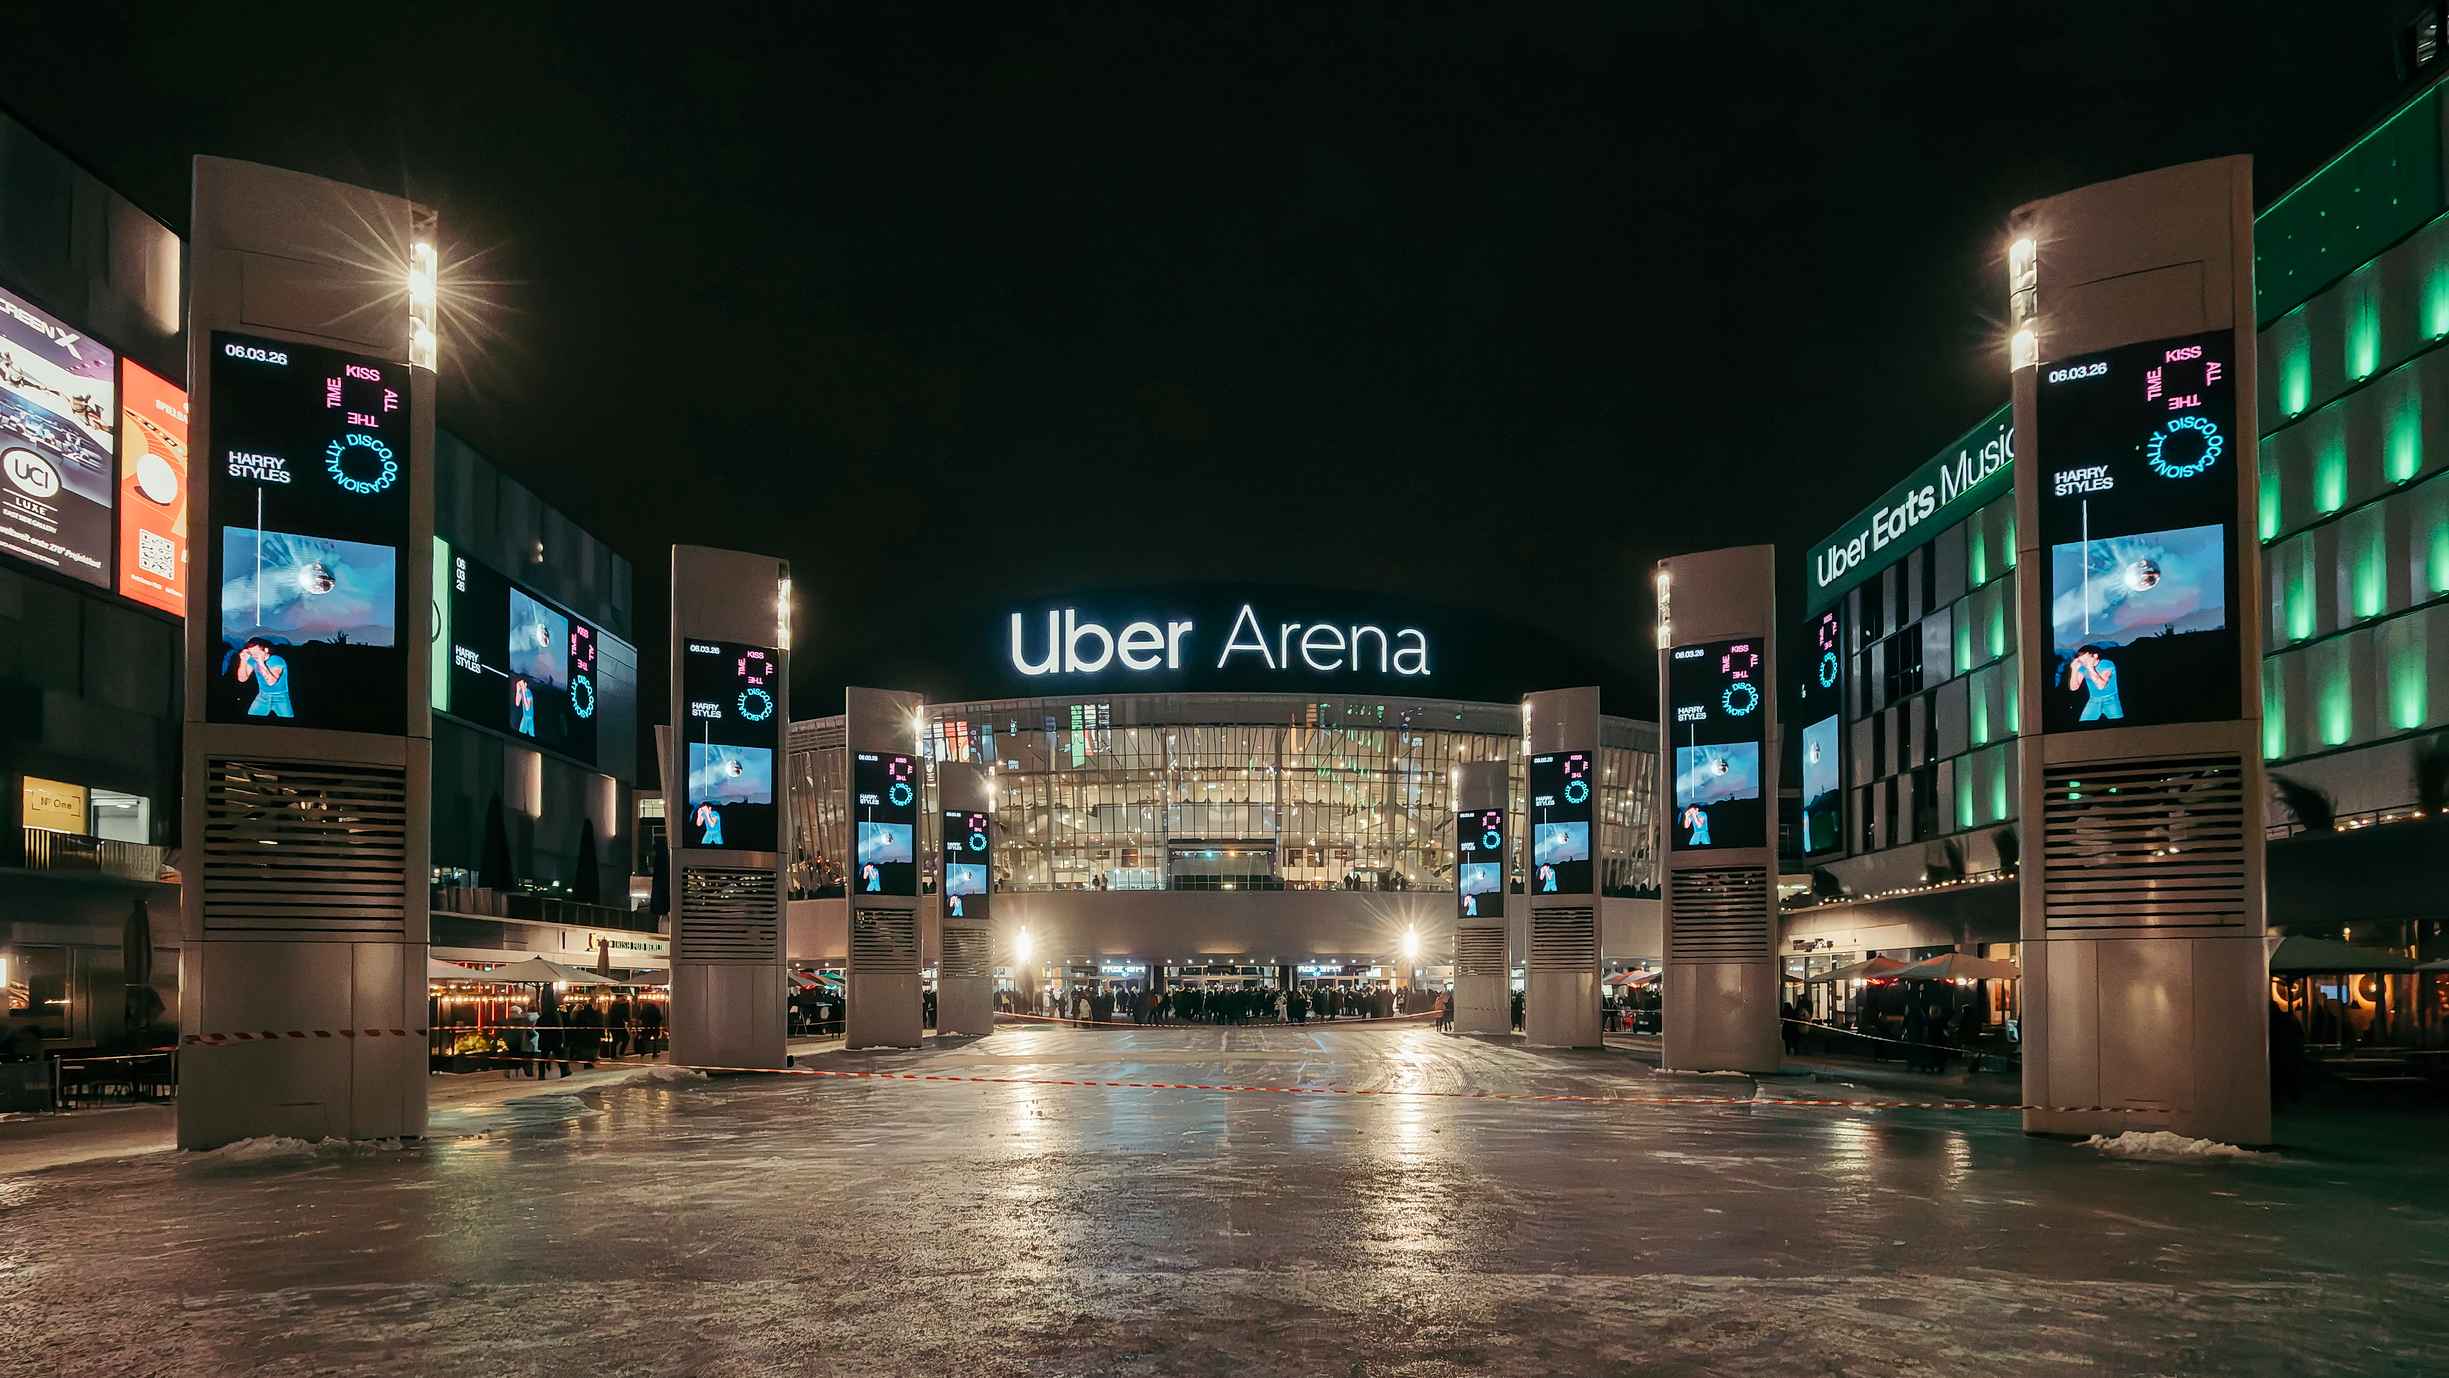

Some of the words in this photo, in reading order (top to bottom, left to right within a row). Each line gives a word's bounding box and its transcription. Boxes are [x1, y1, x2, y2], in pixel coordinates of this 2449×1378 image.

[225, 344, 288, 365] 06.03.26
[2165, 345, 2202, 363] KISS
[346, 364, 381, 382] KISS
[2049, 362, 2108, 383] 06.03.26
[2206, 362, 2222, 386] ALL
[384, 388, 399, 412] ALL
[2168, 394, 2202, 410] THE
[347, 411, 379, 428] THE
[229, 451, 286, 469] HARRY
[14, 458, 49, 489] UCI
[228, 463, 291, 483] STYLES
[2054, 465, 2108, 484] HARRY
[2054, 477, 2114, 496] STYLES
[15, 497, 48, 515] LUXE
[1816, 529, 1869, 587] Uber
[1872, 484, 1935, 551] Eats
[1011, 608, 1193, 675] Uber
[1217, 604, 1431, 675] Arena
[455, 644, 480, 663] HARRY
[455, 655, 481, 674] STYLES
[692, 702, 719, 711] HARRY
[692, 708, 721, 719] STYLES
[1678, 705, 1704, 714] HARRY
[1678, 711, 1707, 722] STYLES
[53, 799, 72, 810] One
